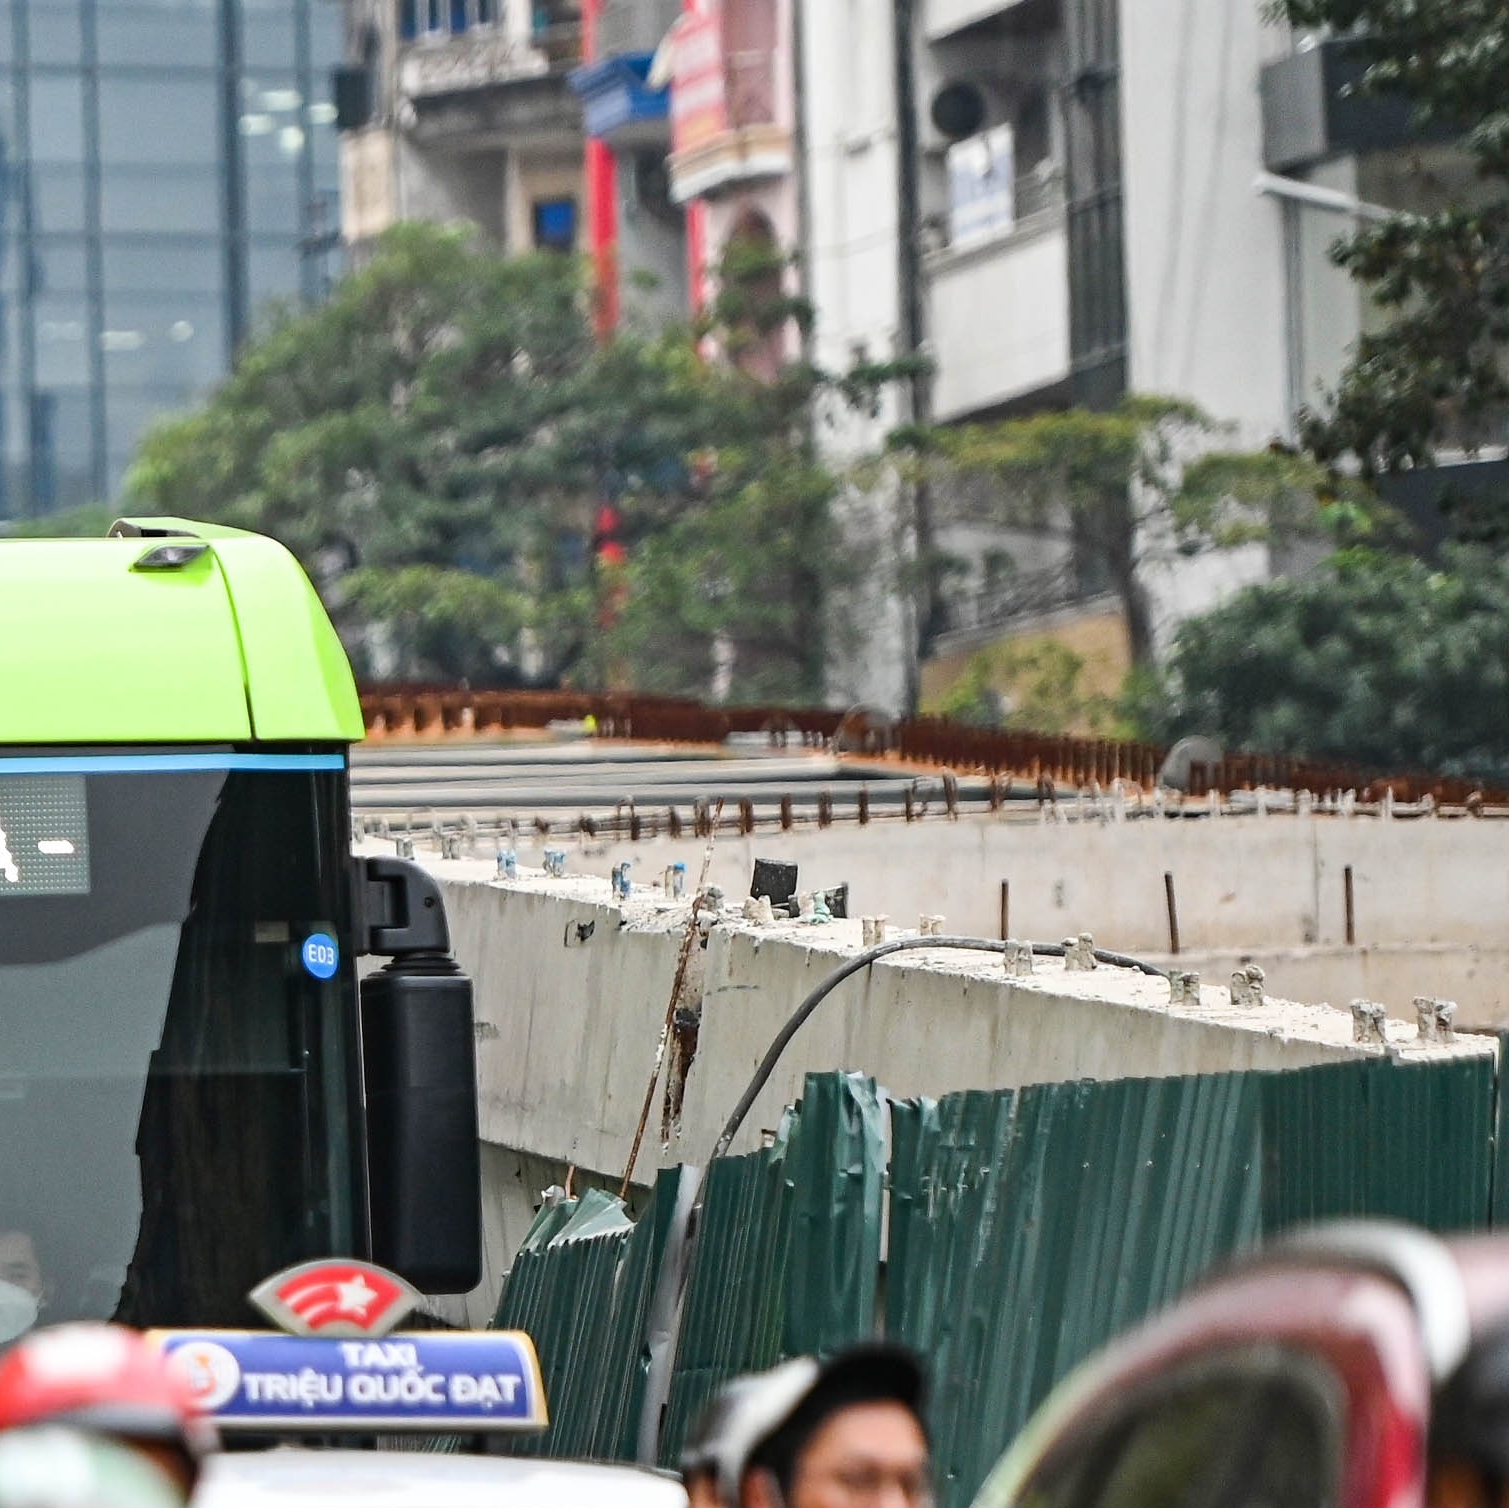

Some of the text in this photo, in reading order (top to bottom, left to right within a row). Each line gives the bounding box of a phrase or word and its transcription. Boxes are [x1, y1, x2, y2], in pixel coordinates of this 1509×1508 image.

[308, 943, 334, 965] E03
[340, 1342, 417, 1370] TAXI
[243, 1364, 522, 1408] TRIỆU QUỐC ĐẠT
